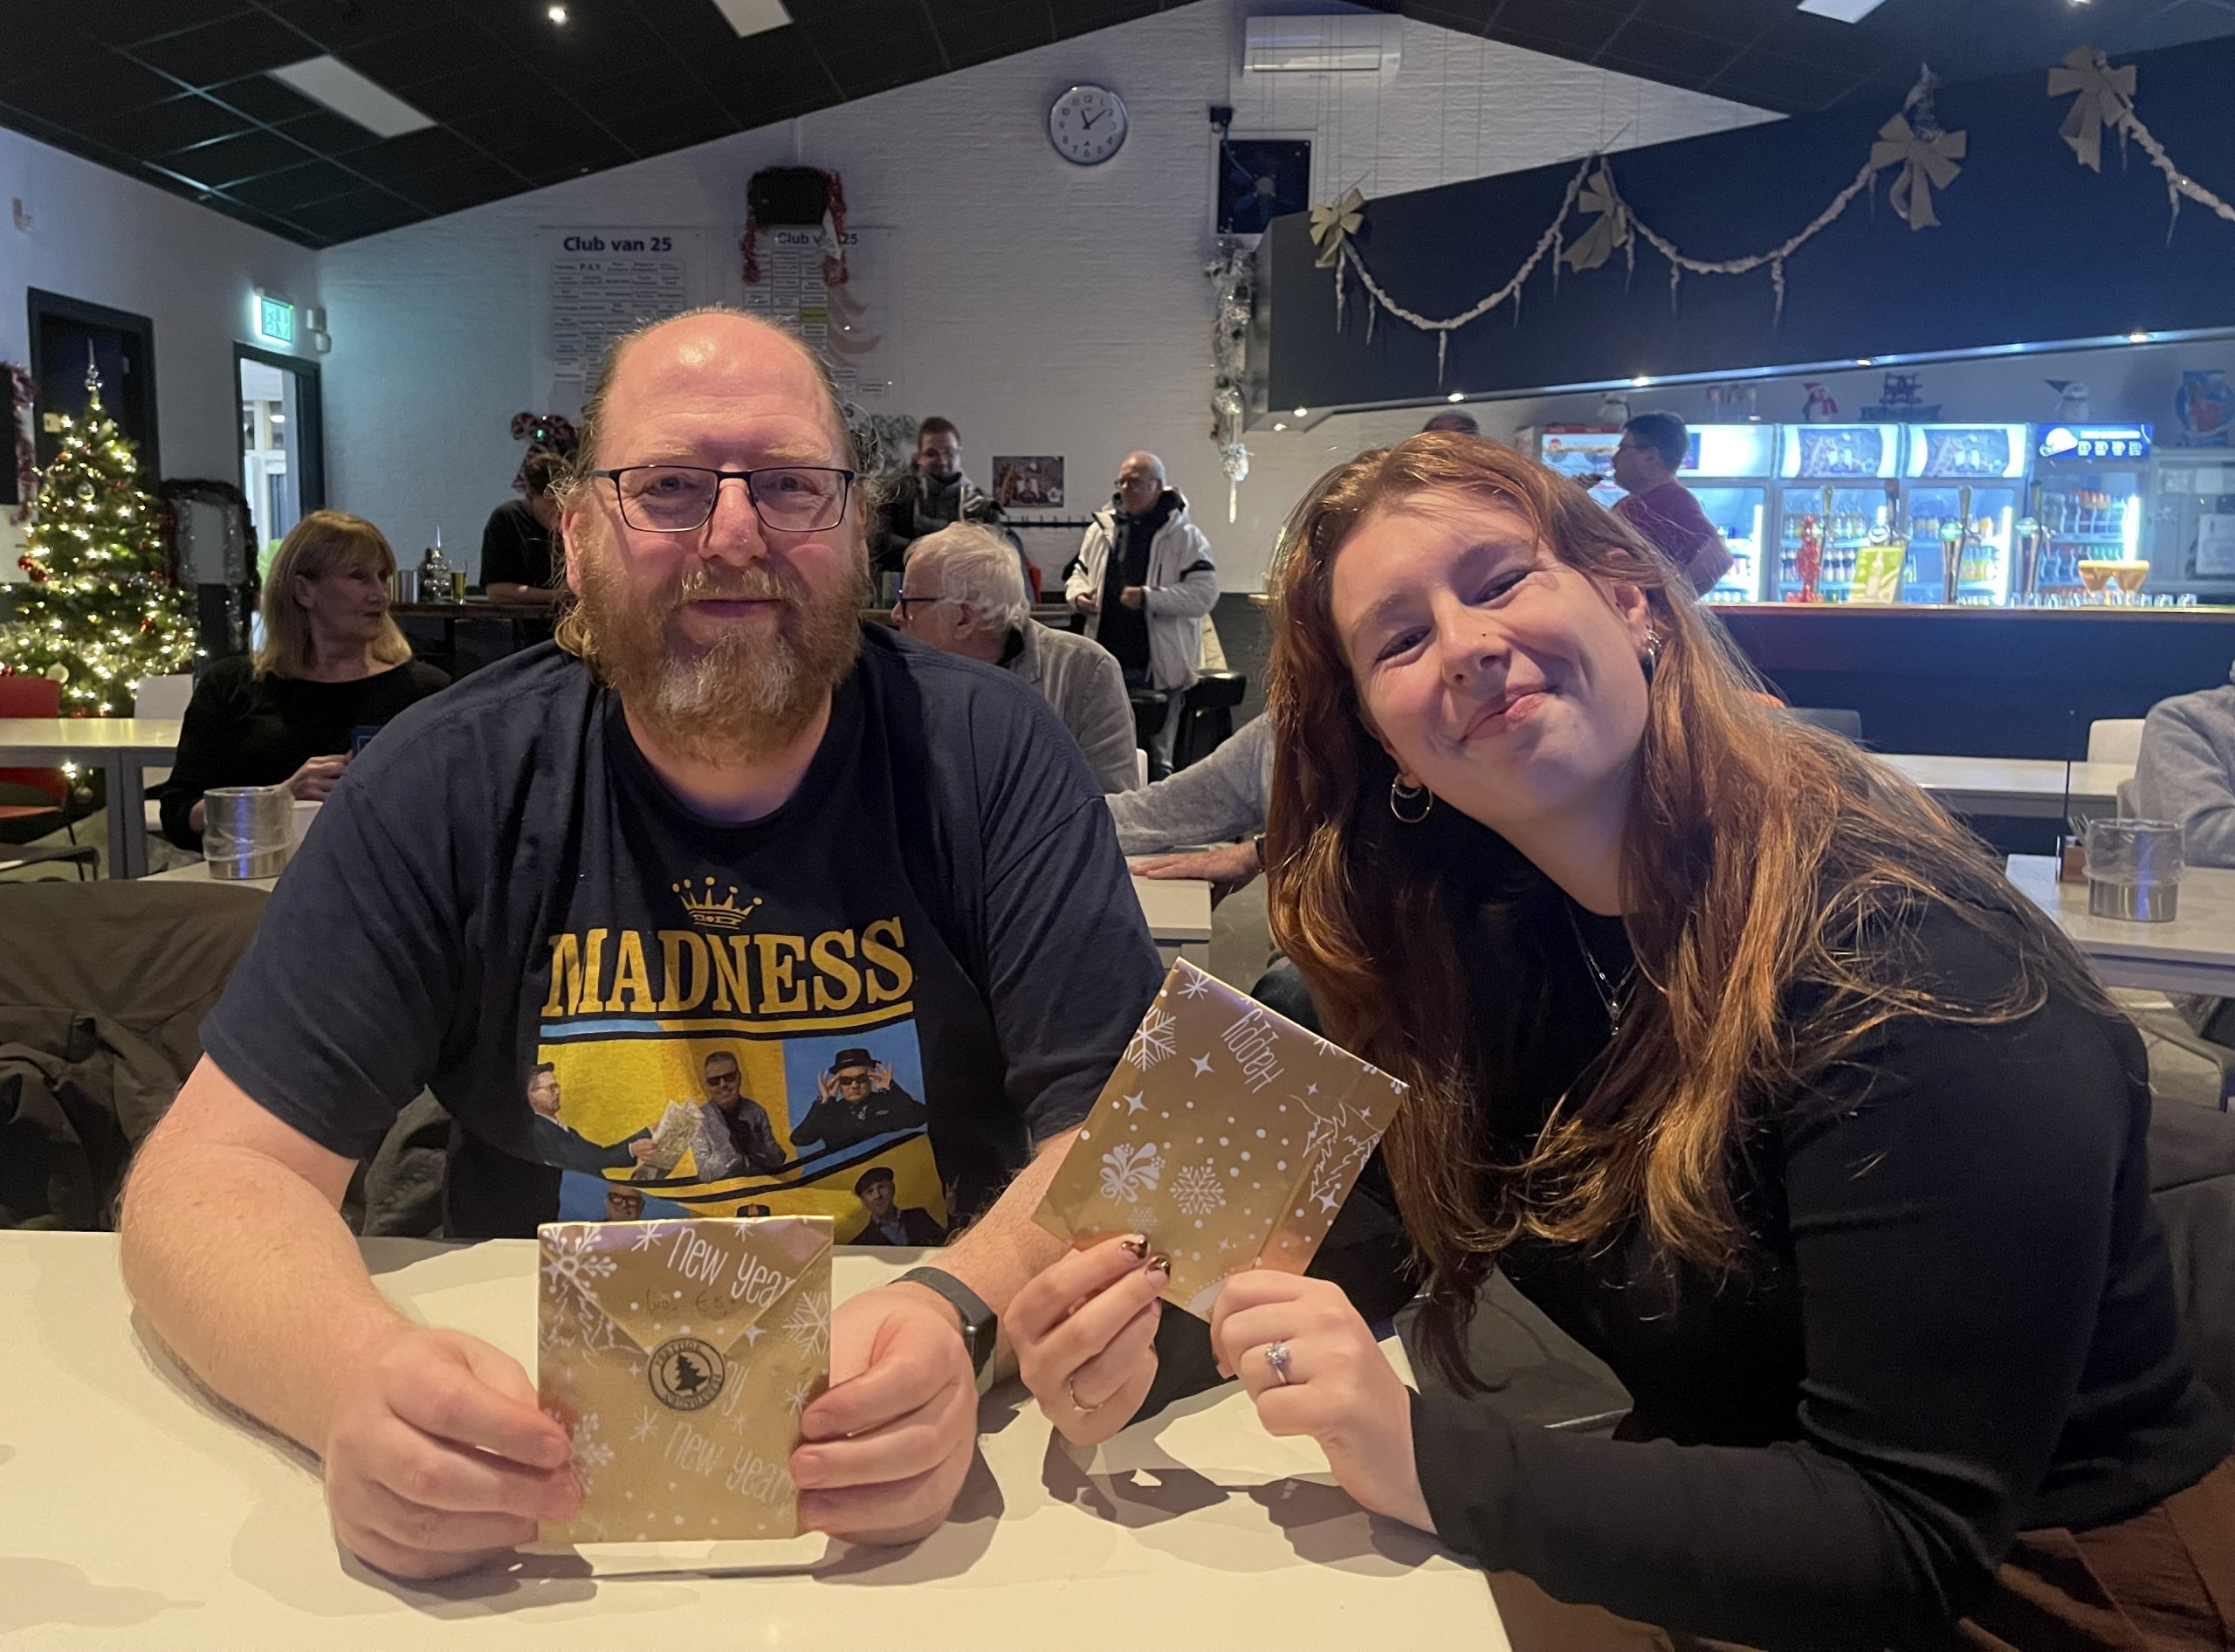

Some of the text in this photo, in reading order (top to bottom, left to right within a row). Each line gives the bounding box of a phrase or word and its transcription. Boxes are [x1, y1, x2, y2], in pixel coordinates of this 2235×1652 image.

[563, 236, 672, 251] Club van 25
[777, 231, 808, 244] Club
[540, 915, 914, 1017] MADNESS
[1221, 1008, 1286, 1094] Happy
[667, 1225, 728, 1286] new
[664, 1420, 726, 1477] new
